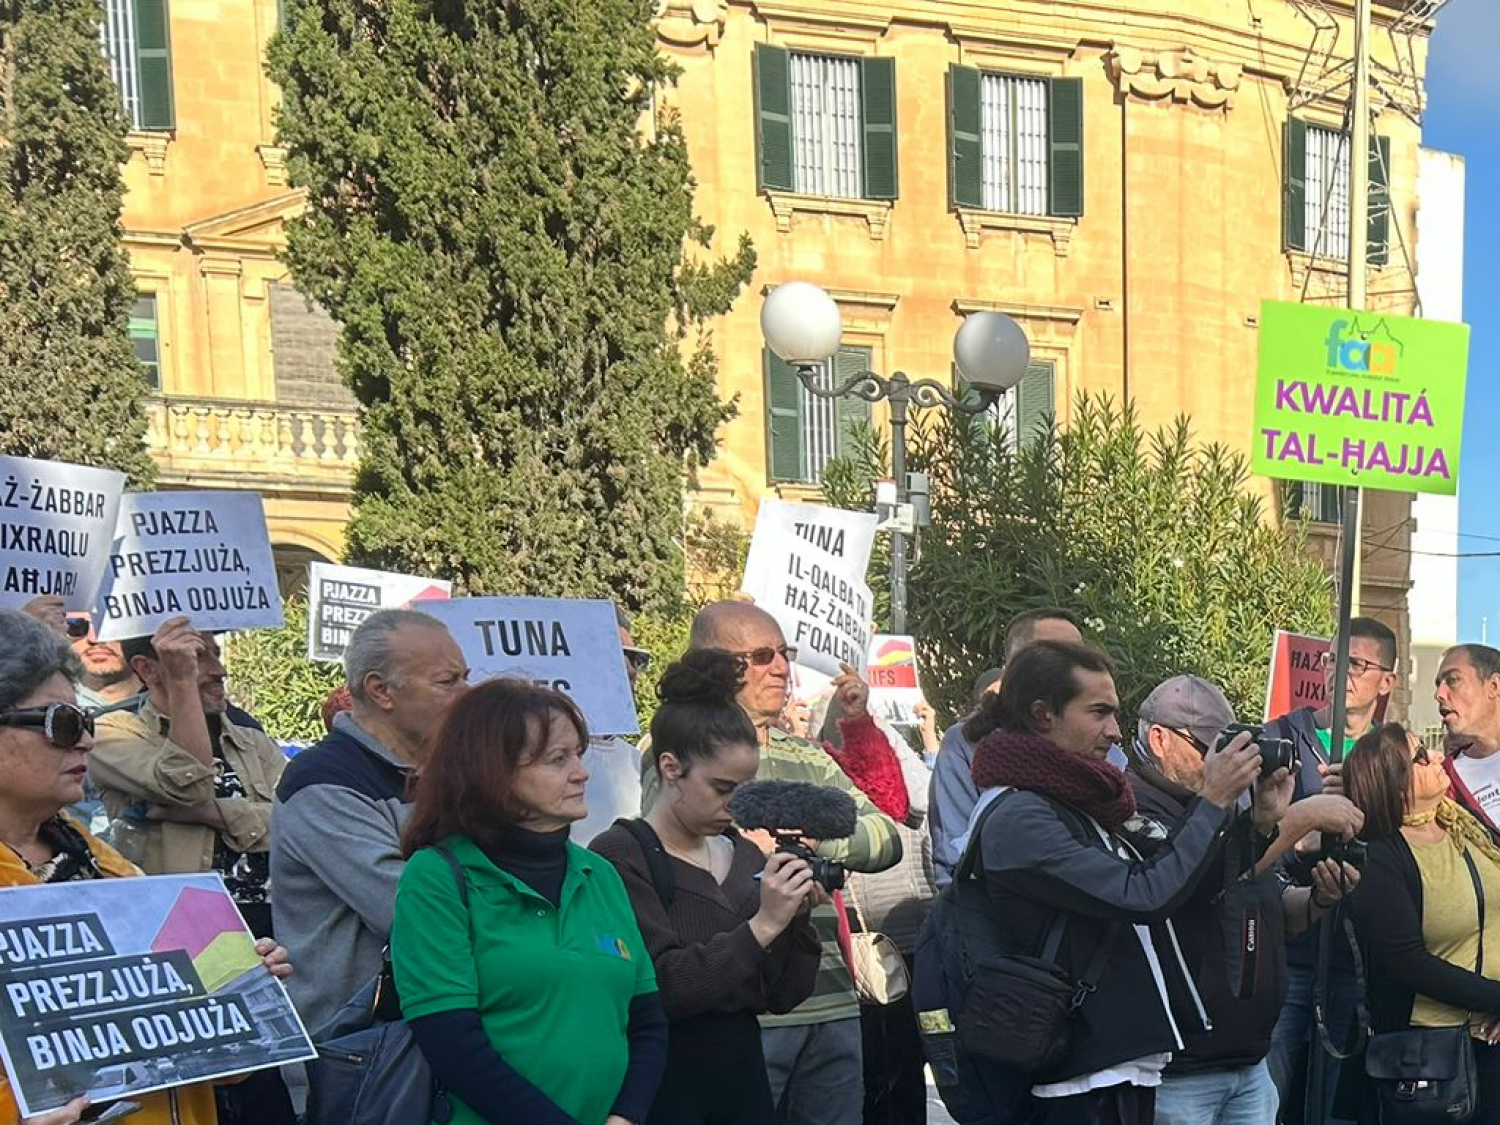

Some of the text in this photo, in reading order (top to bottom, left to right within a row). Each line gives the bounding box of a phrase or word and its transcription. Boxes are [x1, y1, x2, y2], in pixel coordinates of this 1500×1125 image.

[1261, 428, 1451, 479] TAL-ĦAJJA
[0, 475, 105, 518] Ż-ŻABBAR
[0, 523, 89, 558] IXRAQLU
[130, 510, 219, 537] PJAZZA
[110, 542, 250, 578] PREZZJUŻA,
[4, 566, 79, 596] AĦJAR!
[323, 582, 378, 604] PJAZZA
[788, 552, 854, 610] IL-QALBA
[104, 580, 271, 619] BINJA ODJUŻA
[322, 604, 372, 625] PREZZ
[321, 627, 350, 647] BIN
[474, 620, 571, 656] TUNA
[1247, 919, 1255, 951] Canon
[6, 958, 193, 1017] PREZZJUŻA,
[26, 999, 252, 1071] BINJA ODJUŻA
